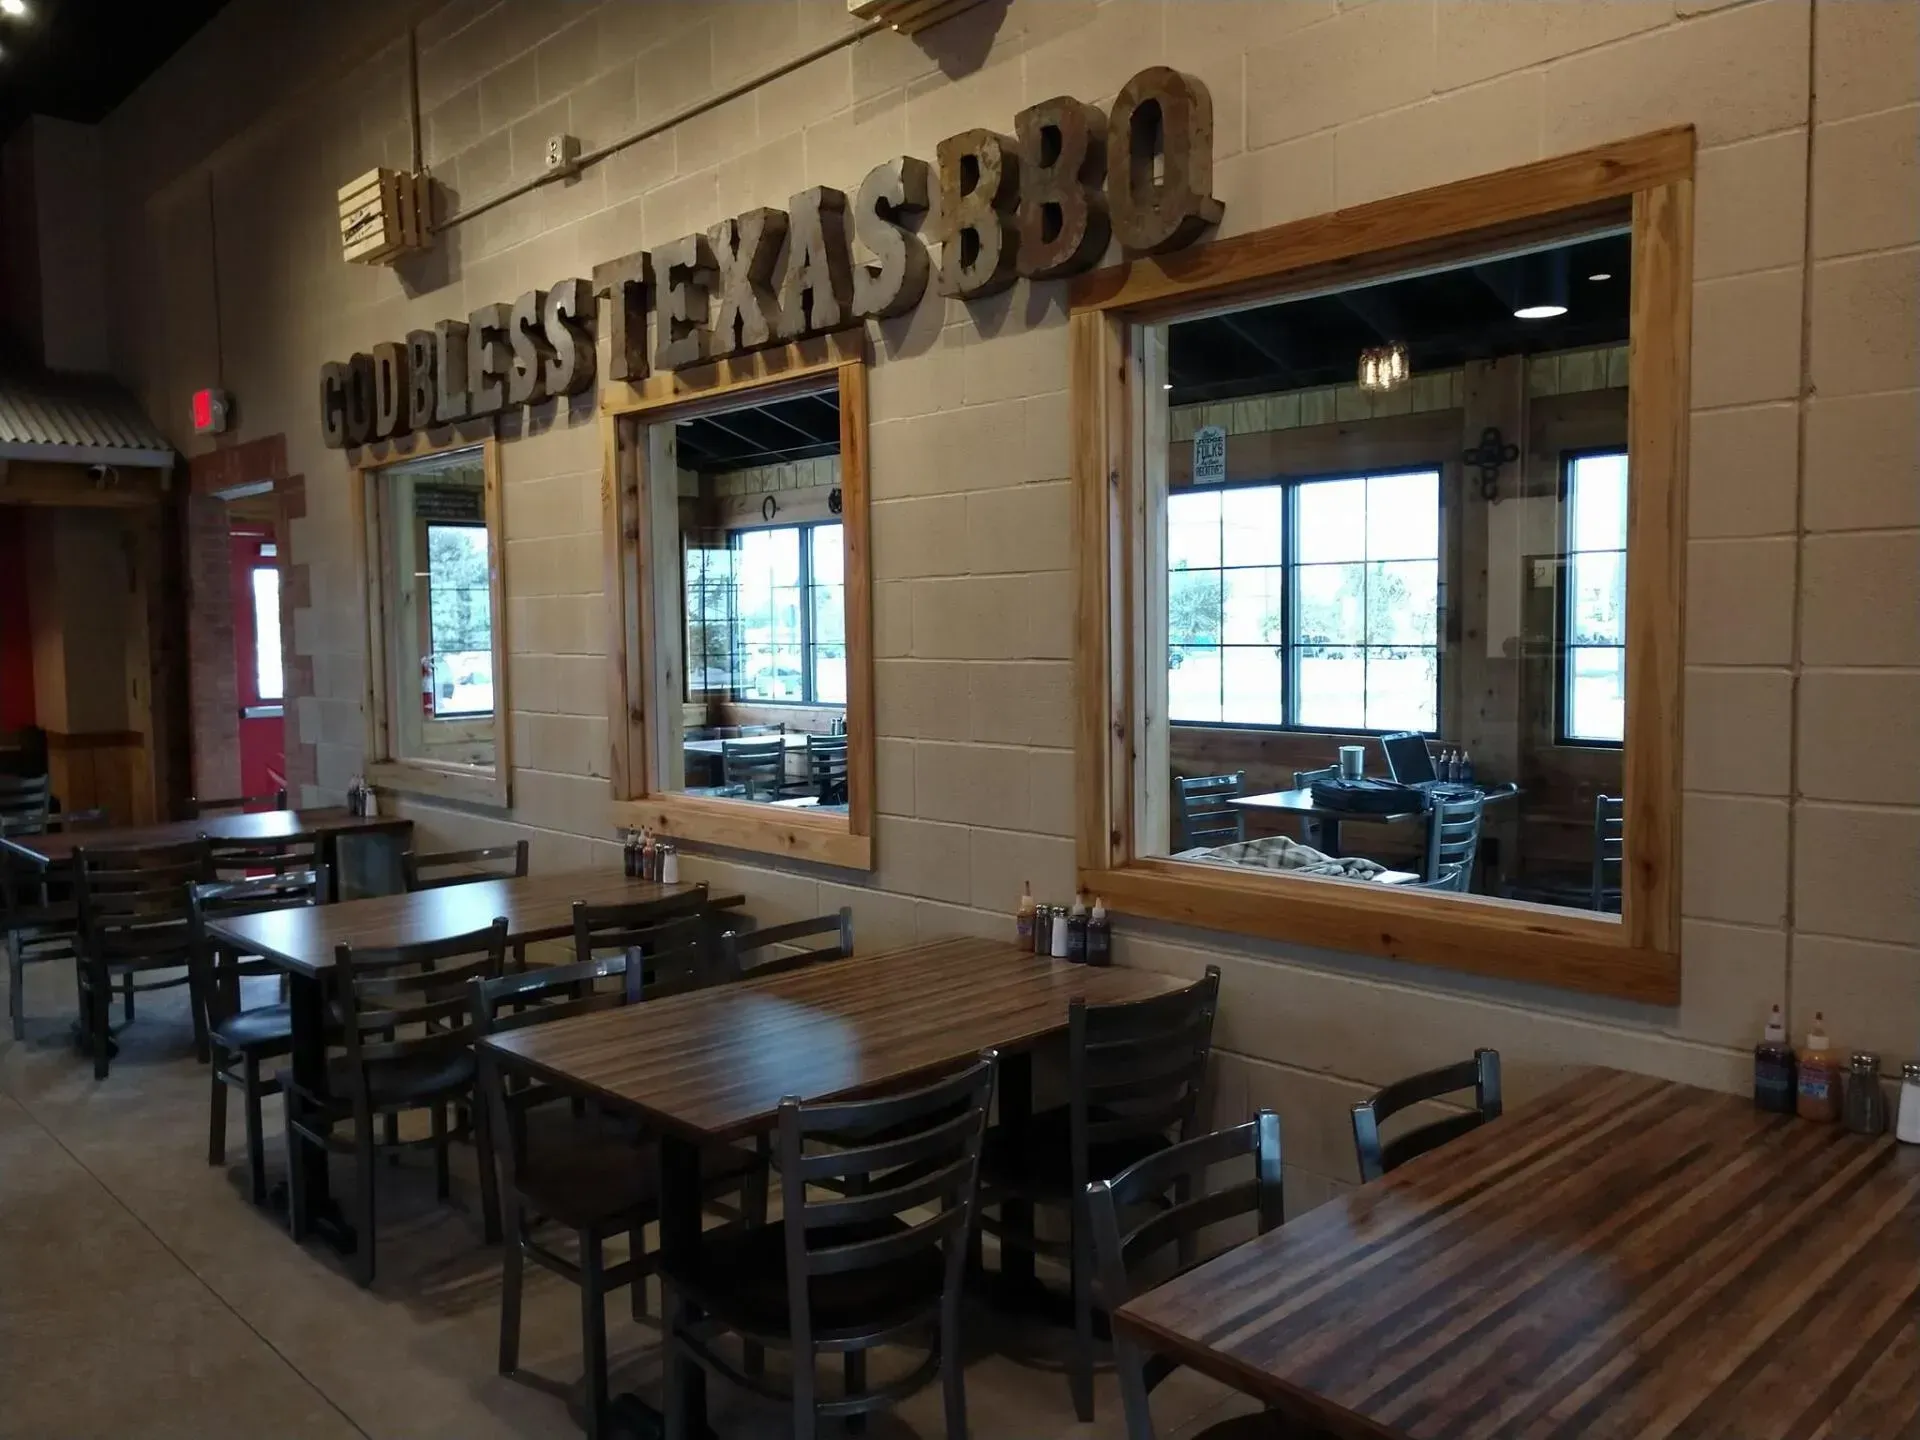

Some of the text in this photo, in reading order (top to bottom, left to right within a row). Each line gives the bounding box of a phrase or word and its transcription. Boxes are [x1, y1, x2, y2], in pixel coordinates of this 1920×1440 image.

[320, 65, 1225, 449] GOD BLESS TEXAS BBQ
